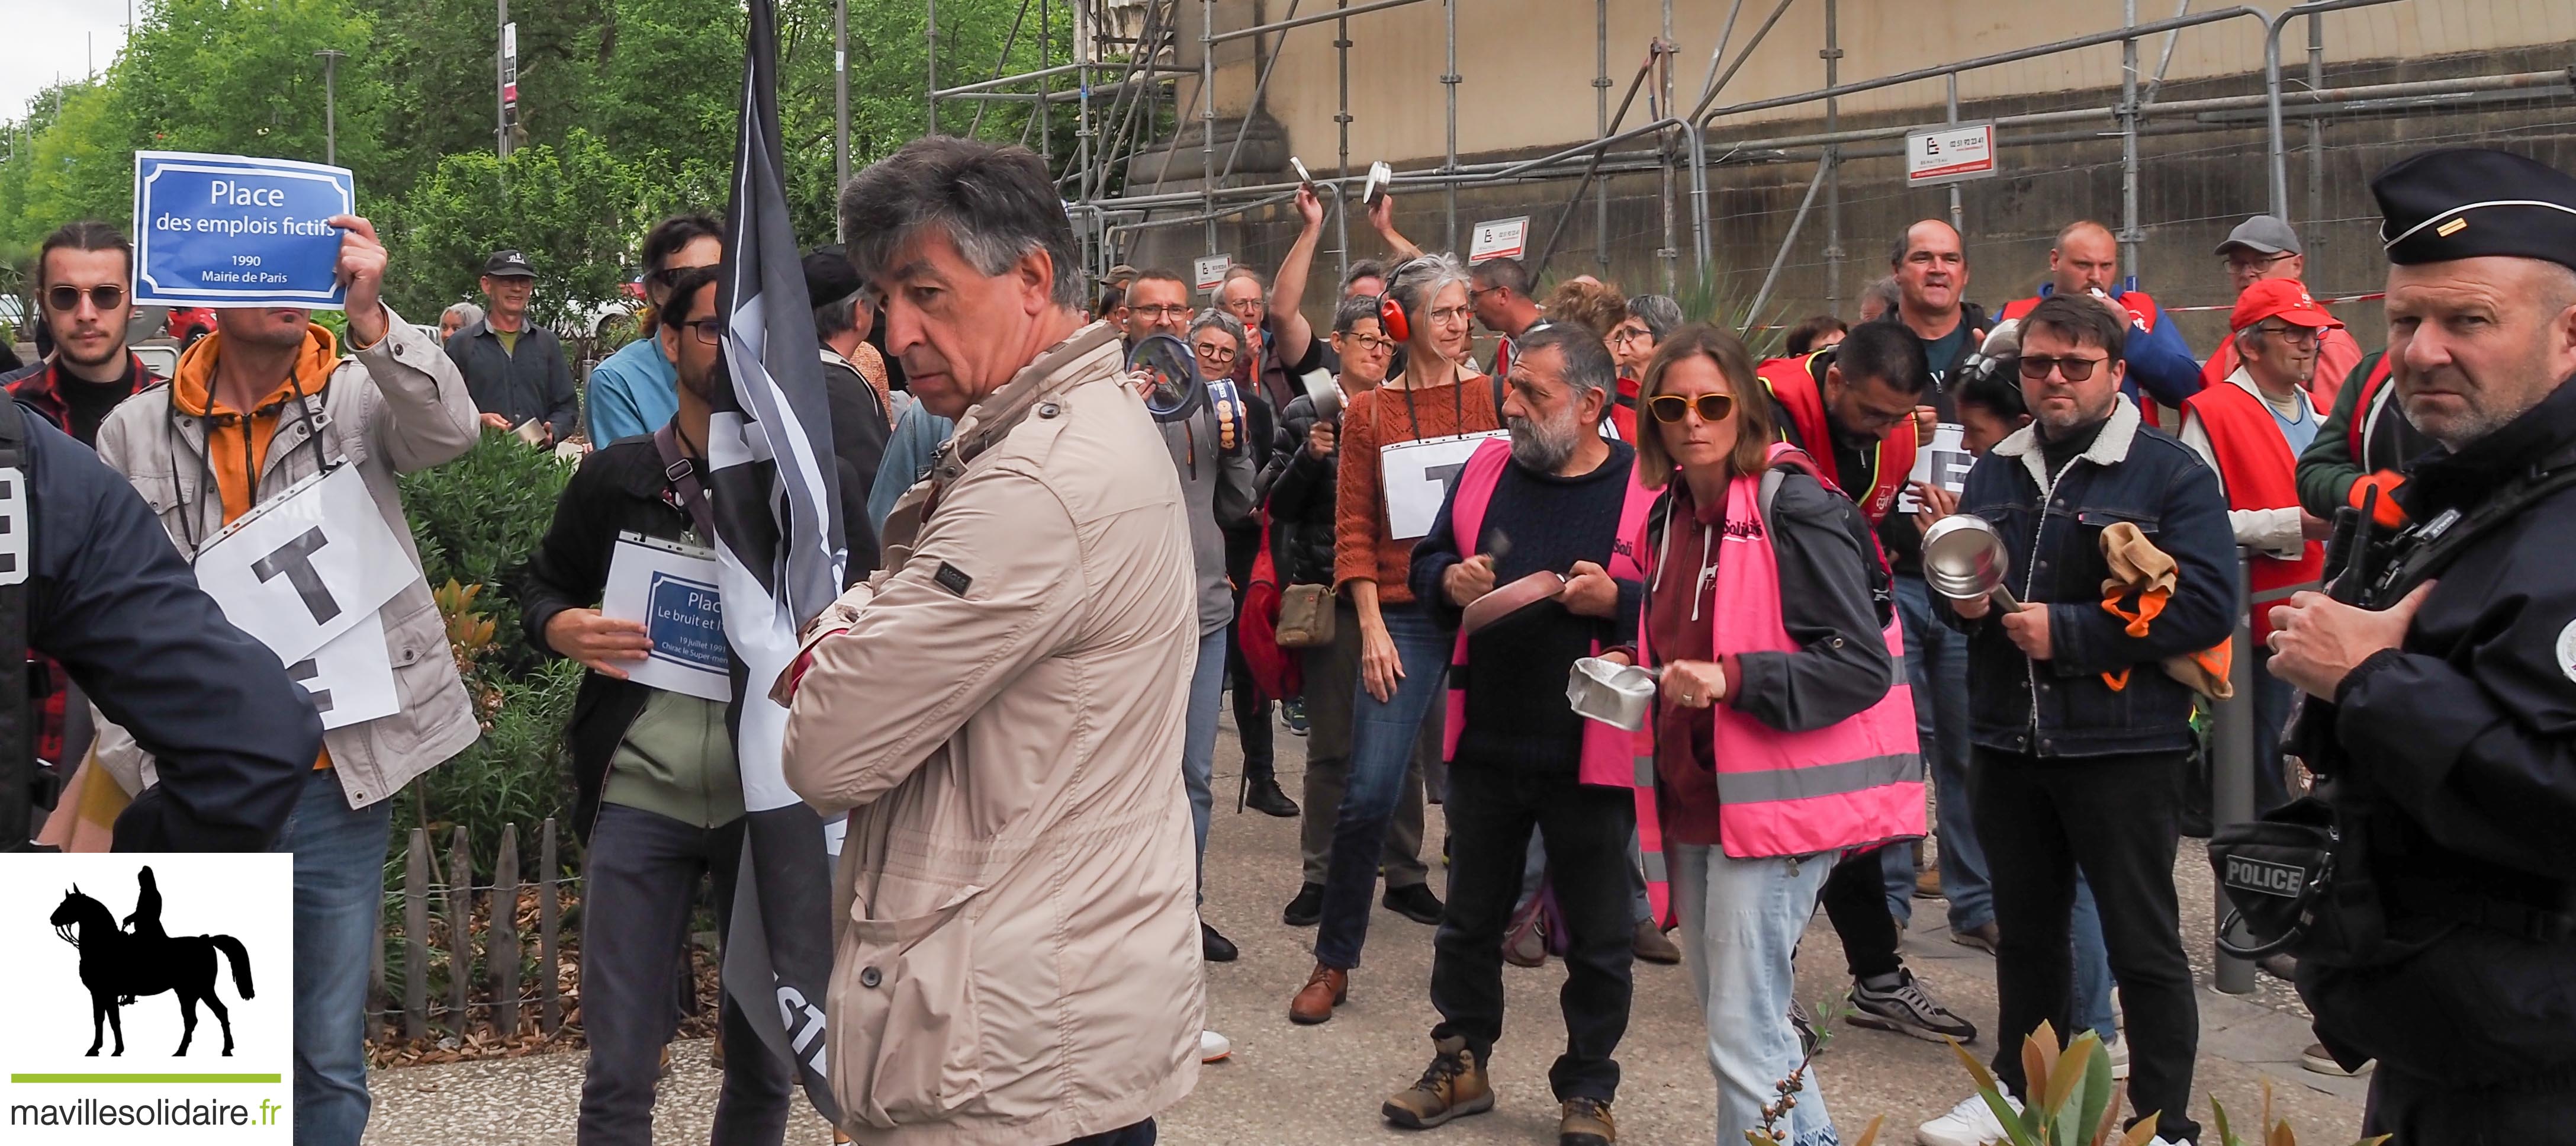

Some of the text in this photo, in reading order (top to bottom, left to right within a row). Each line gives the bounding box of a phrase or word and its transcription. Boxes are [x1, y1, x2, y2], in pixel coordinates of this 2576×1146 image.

[211, 181, 284, 207] Place
[156, 213, 336, 237] des emplois fictifs
[232, 255, 261, 267] 1990
[202, 271, 288, 283] Mairie de Paris
[250, 525, 342, 626] T
[688, 592, 722, 613] Plac
[658, 606, 671, 619] Le
[673, 609, 700, 627] bruit
[702, 619, 713, 630] et
[662, 641, 681, 653] Chirac
[683, 647, 689, 655] le
[688, 638, 708, 649] juillet
[2228, 861, 2301, 891] POLICE
